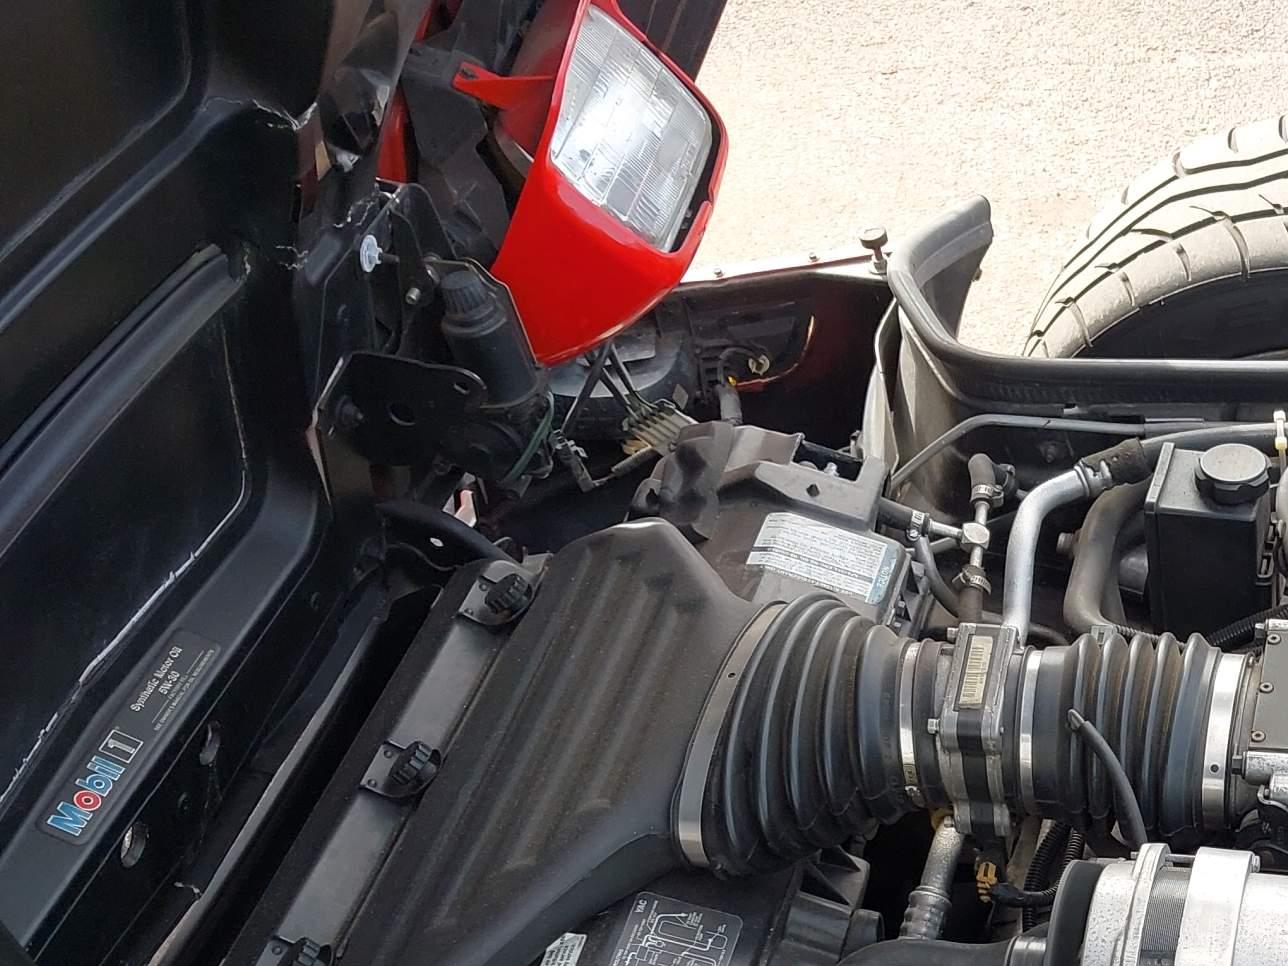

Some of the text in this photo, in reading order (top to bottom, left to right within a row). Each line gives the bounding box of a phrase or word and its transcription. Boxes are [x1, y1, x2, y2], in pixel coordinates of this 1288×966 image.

[130, 646, 182, 712] Synthetic Motor Oil
[158, 670, 180, 694] 5W-30
[46, 754, 125, 837] Mobil
[635, 899, 647, 914] YAC
